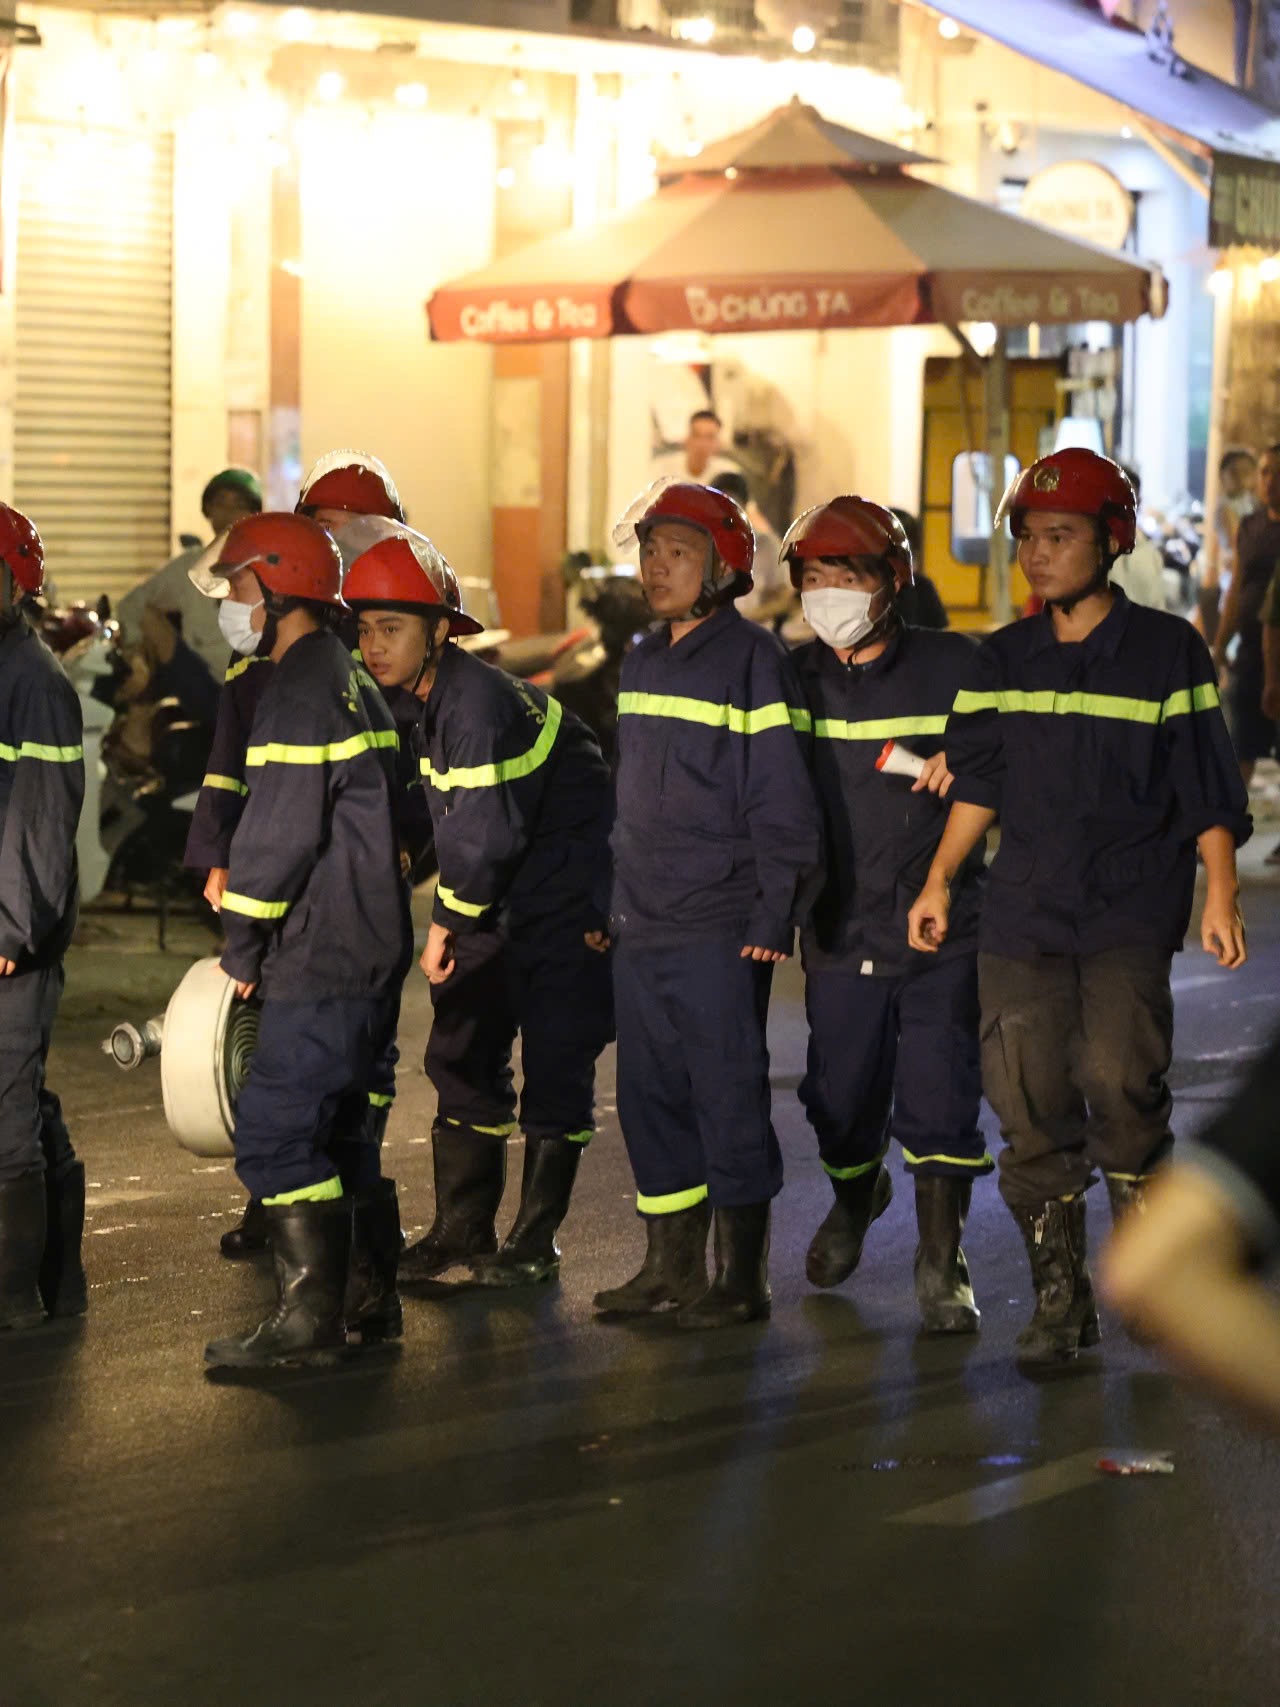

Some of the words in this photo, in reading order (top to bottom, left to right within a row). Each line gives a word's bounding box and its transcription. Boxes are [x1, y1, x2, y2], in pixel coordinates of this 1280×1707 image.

[460, 301, 529, 337] Coffee
[532, 299, 554, 331] &
[556, 296, 597, 330] Tea
[962, 287, 1040, 320] Coffee
[1076, 286, 1119, 316] Tea
